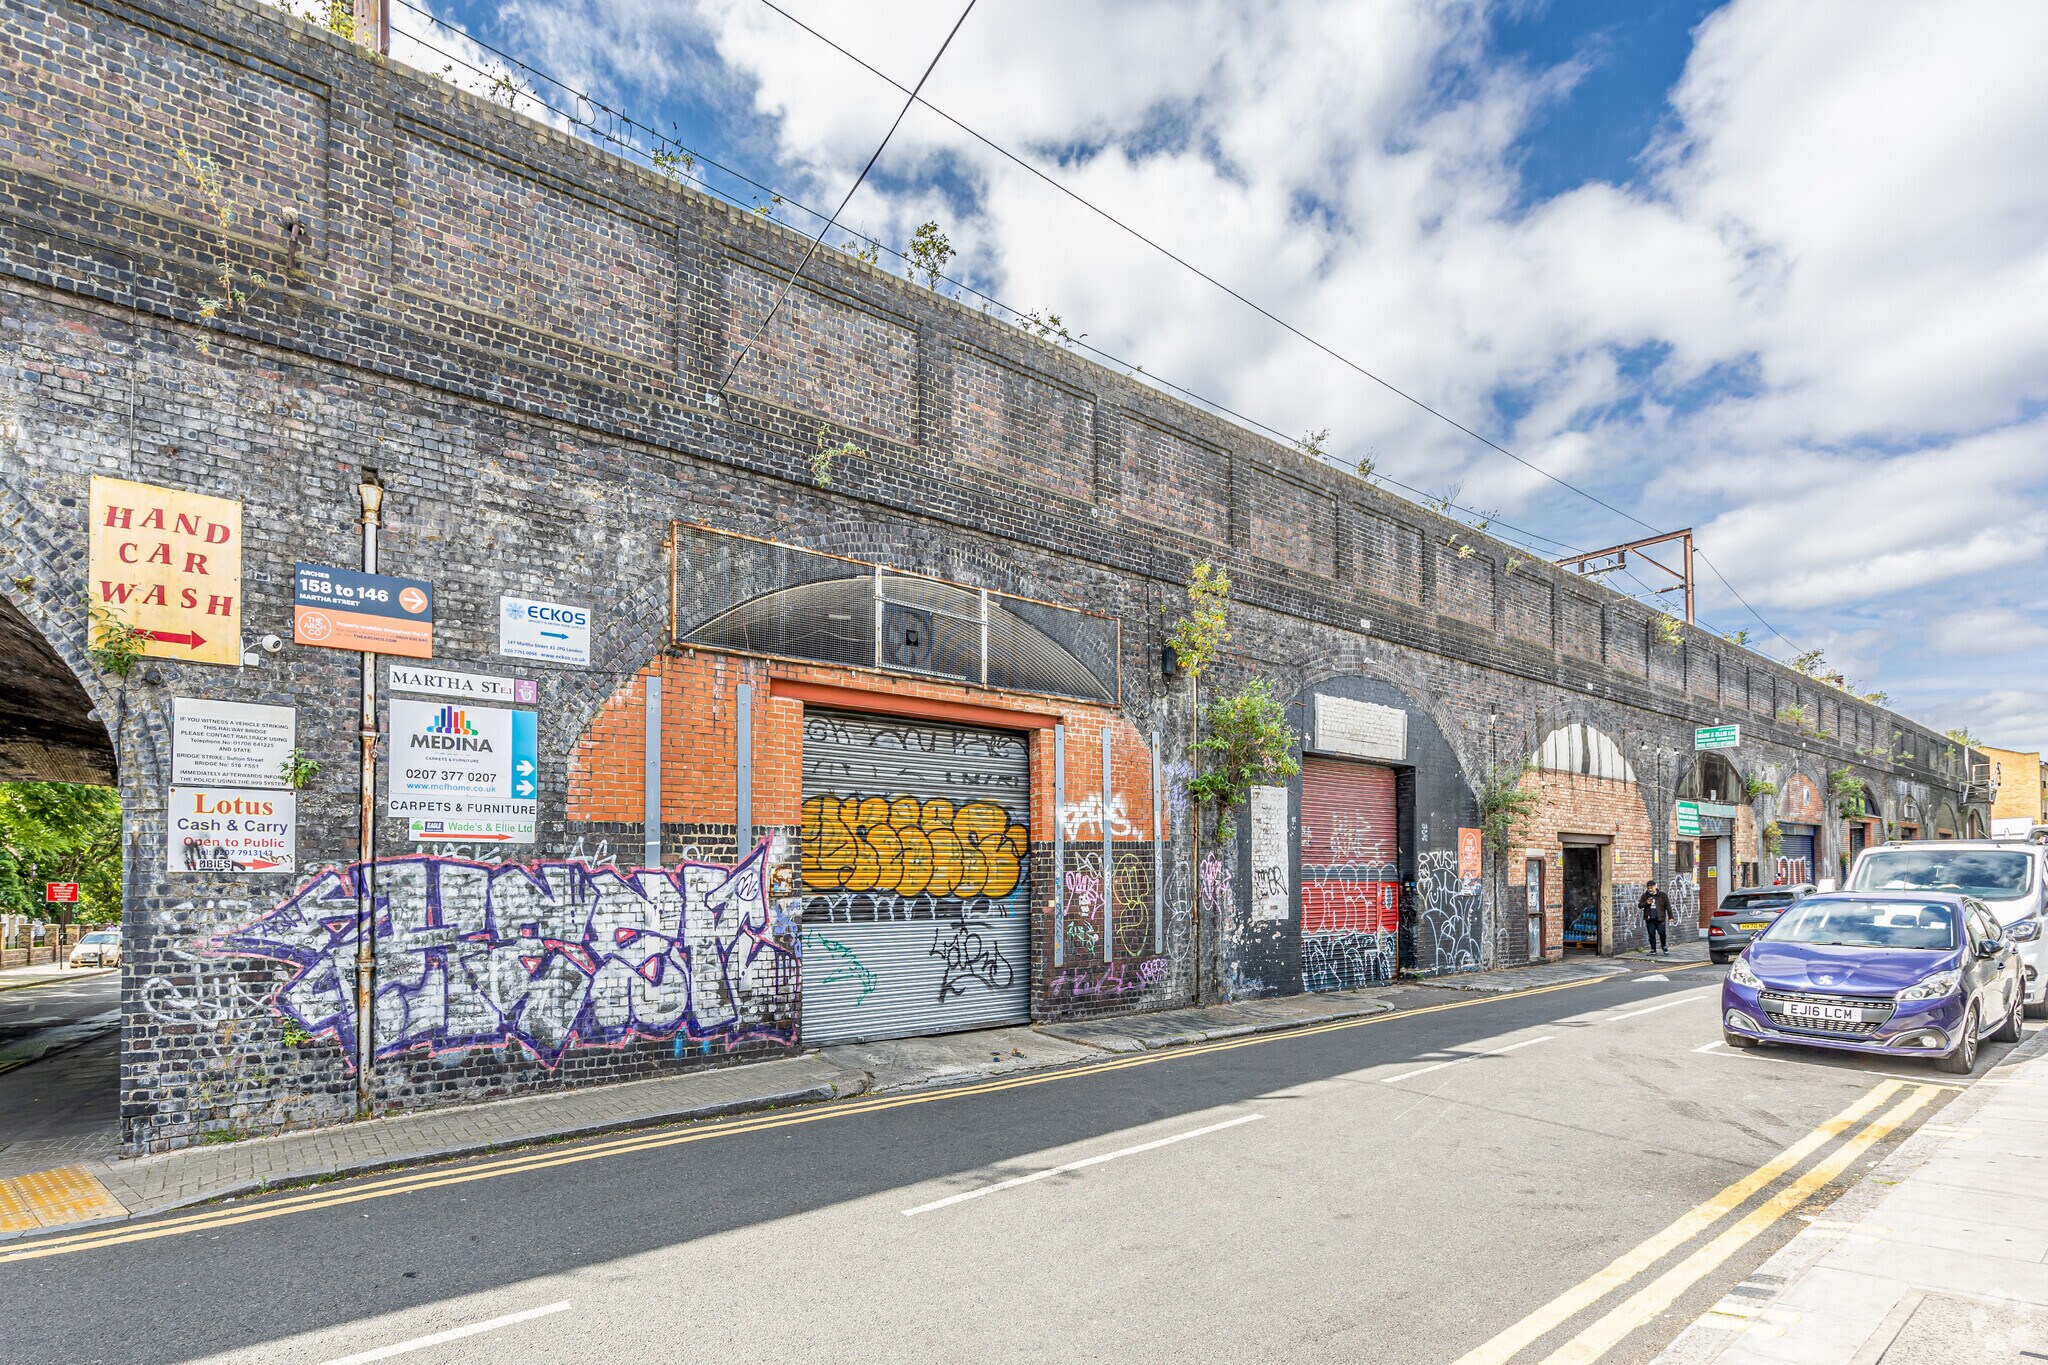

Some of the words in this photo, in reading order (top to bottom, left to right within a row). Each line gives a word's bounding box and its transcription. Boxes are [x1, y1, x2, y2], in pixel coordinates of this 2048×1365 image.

[104, 505, 230, 544] HAND
[119, 542, 209, 575] CAR
[300, 569, 330, 578] ARCHES
[300, 578, 332, 594] 158
[335, 584, 354, 597] to
[357, 587, 389, 602] 146
[99, 580, 234, 617] WASH
[299, 593, 332, 602] MARTHA
[332, 598, 360, 606] STREET
[307, 616, 322, 624] THE
[528, 605, 586, 625] ECKOS
[304, 622, 326, 630] ARCH
[336, 621, 359, 629] Property
[383, 627, 411, 635] throughout
[353, 634, 397, 643] THEARCHCO.COM
[541, 653, 585, 662] www.eckos.co.uk
[392, 671, 474, 692] MARTHA
[481, 681, 500, 693] ST
[500, 687, 512, 695] E.1
[261, 722, 289, 730] STRIKING
[410, 734, 493, 753] MEDINA
[406, 768, 436, 780] 0207
[441, 770, 463, 781] 377
[468, 772, 497, 783] 0207
[407, 782, 496, 793] www.mcfhome.co.uk
[193, 793, 274, 816] Lotus
[390, 800, 451, 811] CARPETS
[455, 803, 463, 812] &
[467, 803, 536, 815] FURNITURE
[177, 818, 220, 831] Cash
[226, 819, 238, 831] &
[244, 820, 288, 835] Carry
[448, 822, 482, 832] Wade's
[485, 823, 493, 832] &
[496, 821, 515, 832] Ellie
[518, 824, 533, 833] Ltd
[183, 836, 219, 849] Open
[225, 838, 239, 847] to
[244, 838, 285, 848] Public
[1791, 1004, 1820, 1017] EJ16
[1825, 1007, 1852, 1020] LCM
